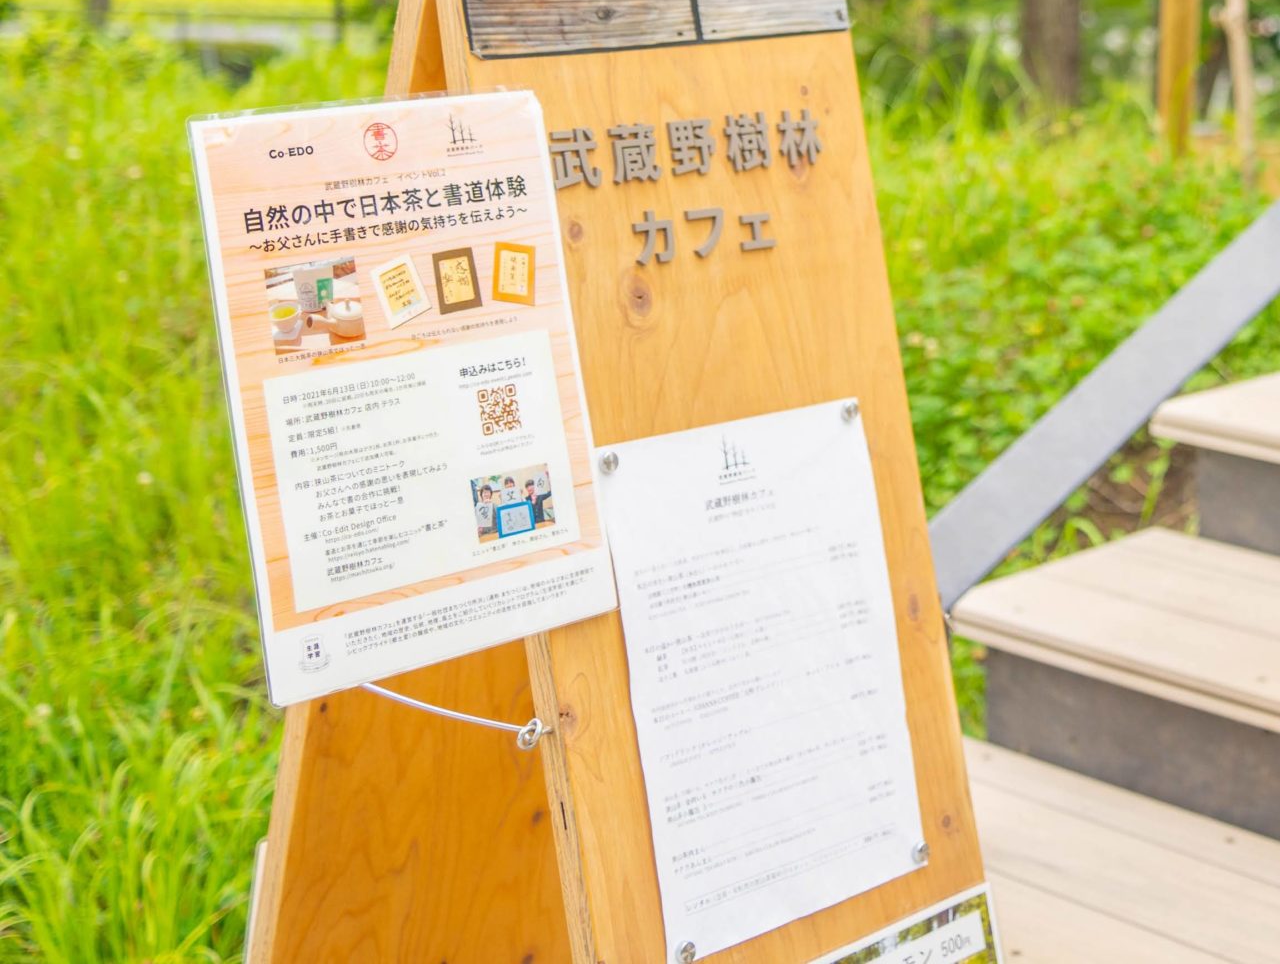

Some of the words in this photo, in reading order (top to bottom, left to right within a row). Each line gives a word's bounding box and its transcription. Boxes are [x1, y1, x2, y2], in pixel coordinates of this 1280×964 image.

[550, 110, 823, 189] 武蔵野樹林
[244, 175, 528, 234] 自然の中で日本茶と書道体験
[632, 208, 776, 266] カフェ
